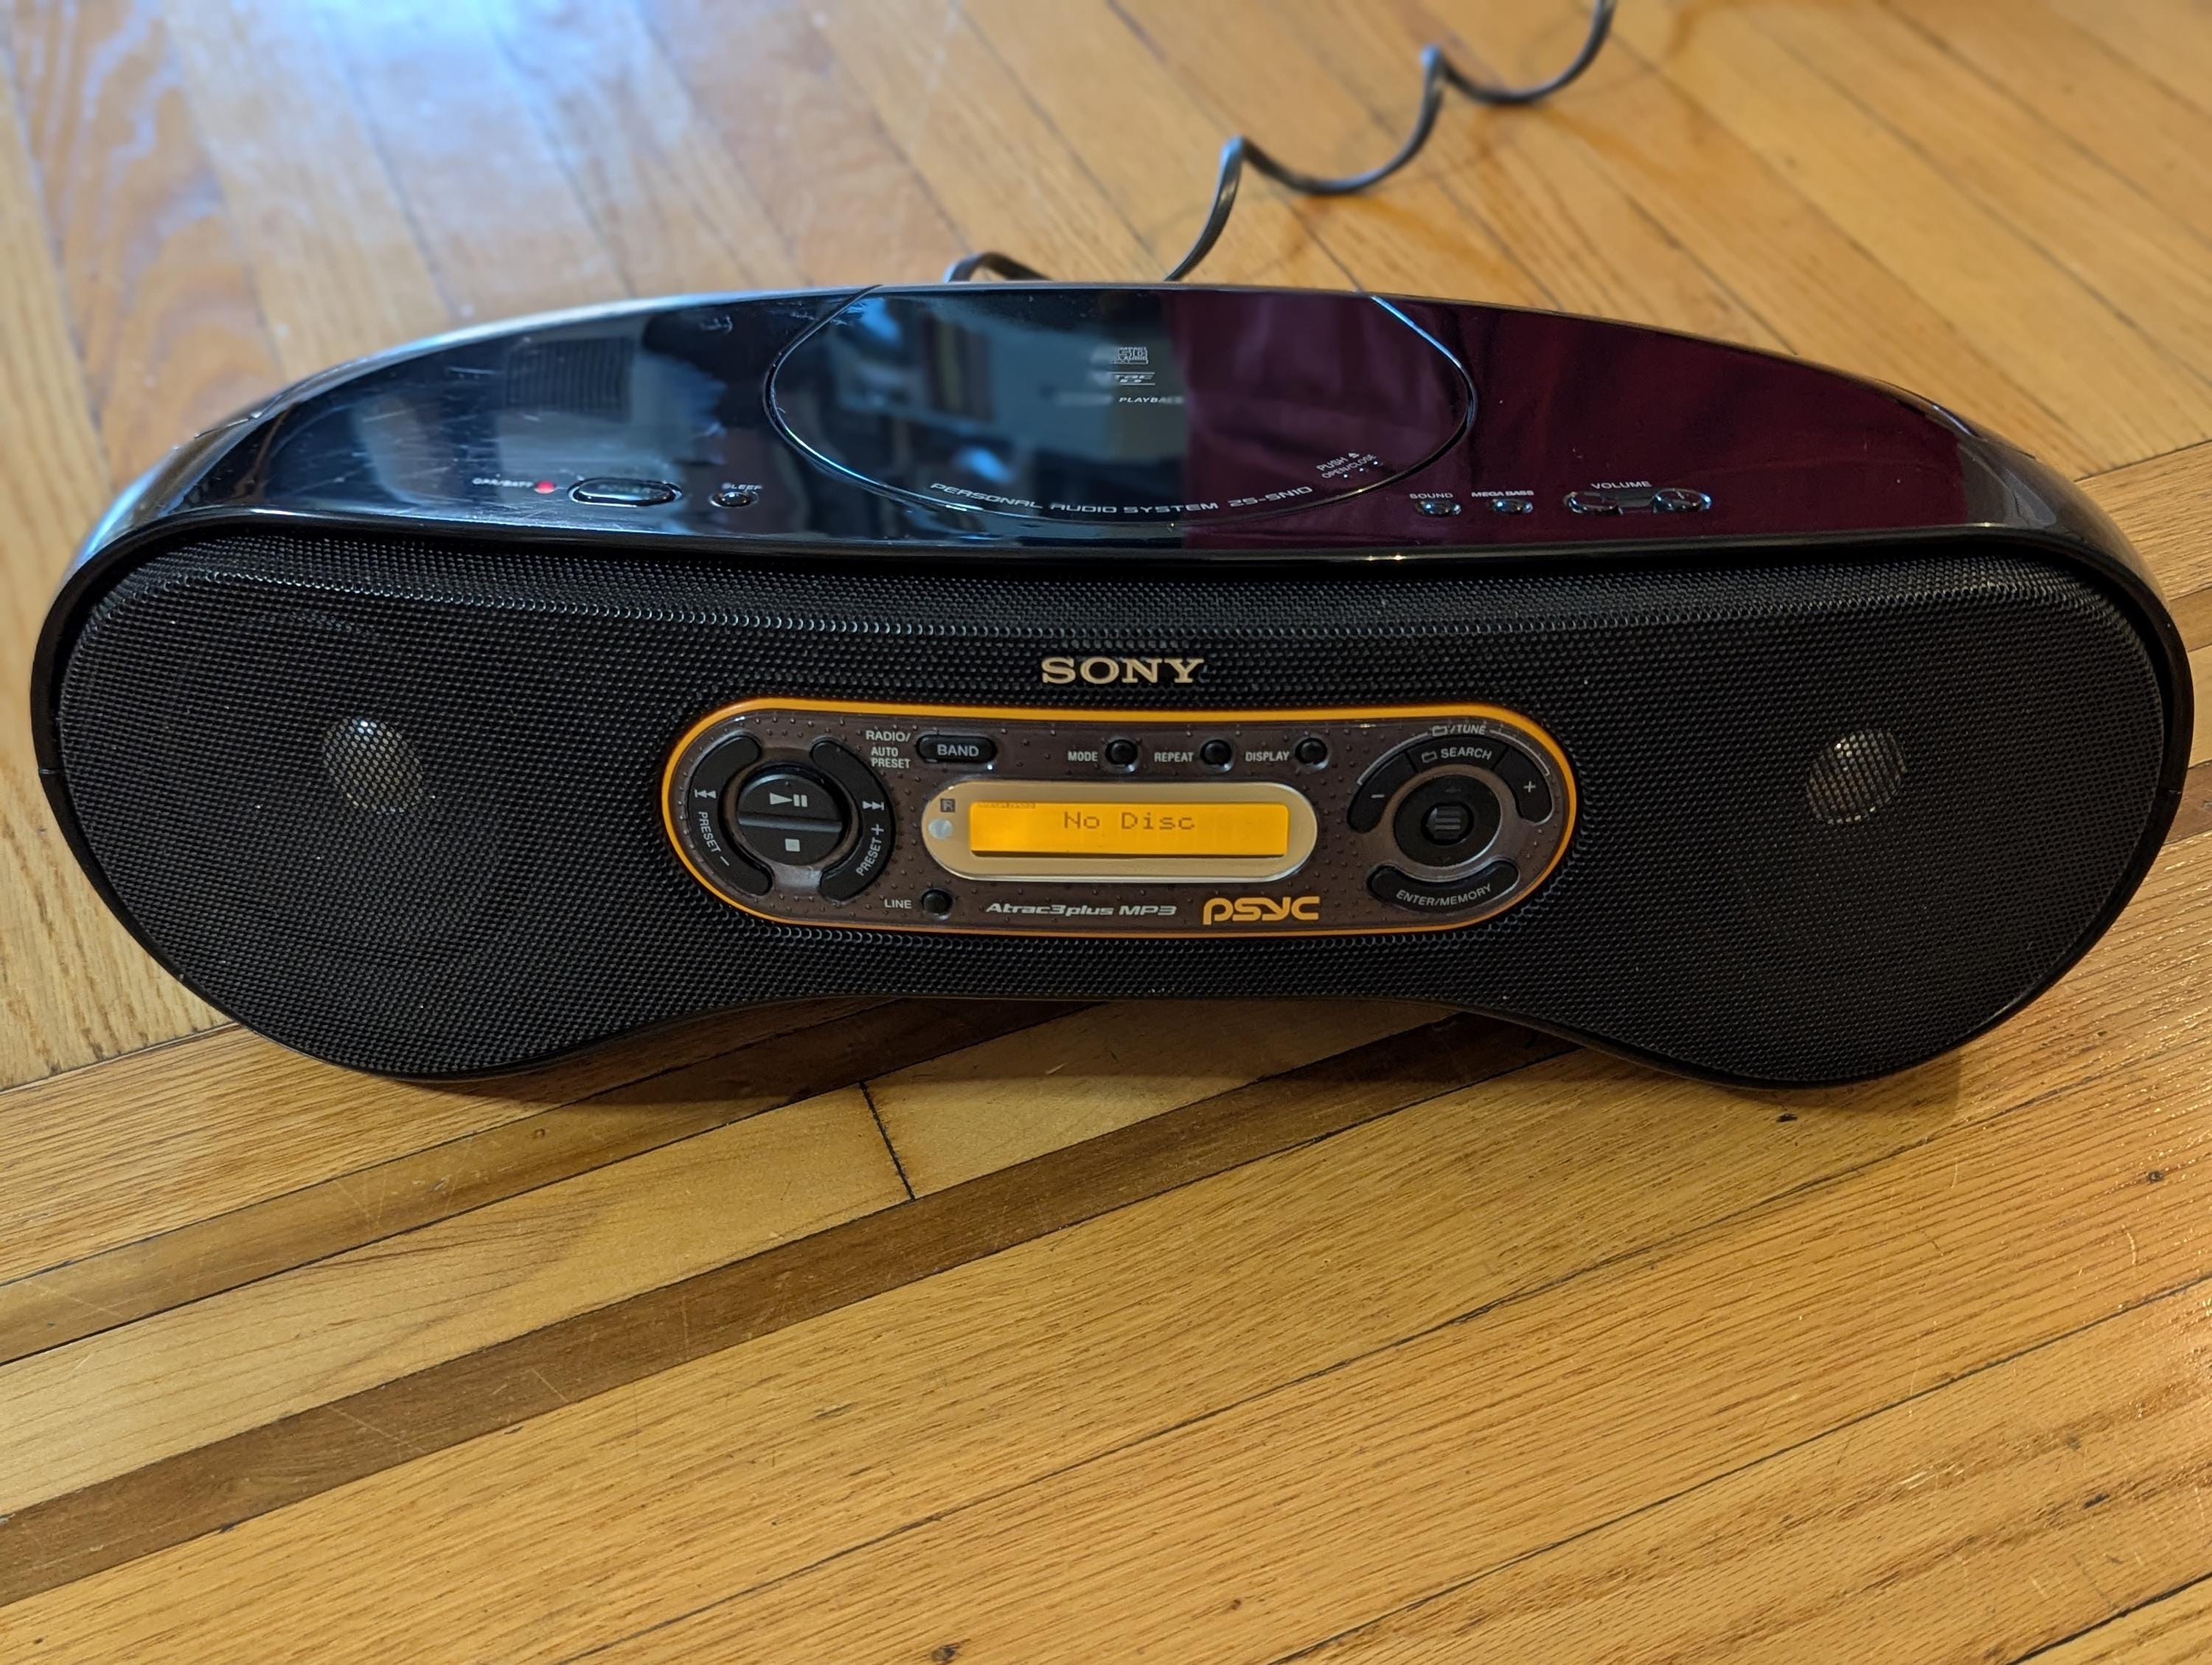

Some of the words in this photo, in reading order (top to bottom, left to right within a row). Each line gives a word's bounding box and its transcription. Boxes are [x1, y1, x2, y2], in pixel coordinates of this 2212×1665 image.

[1316, 456, 1349, 471] PUSH
[1321, 453, 1377, 479] OPEN/CLOSE
[1590, 481, 1652, 490] VOLUME
[930, 483, 1043, 509] PERSONAL
[1050, 503, 1117, 513] AUDIO
[1123, 502, 1219, 513] SYSTEM
[1228, 486, 1313, 507] ZS-SN10
[1041, 656, 1205, 684] SONY
[866, 730, 911, 743] RADIO/
[871, 746, 898, 757] AUTO
[936, 744, 979, 757] BAND
[1068, 751, 1099, 762] MODE
[1154, 751, 1194, 762] REPEAT
[1245, 751, 1290, 762] DISPLAY
[1441, 746, 1492, 759] SEARCH
[871, 758, 911, 768] PRESET
[1064, 811, 1099, 829] No
[1121, 812, 1195, 830] Disc
[698, 810, 722, 853] PRESET
[855, 838, 883, 876] PRESET
[1396, 883, 1492, 906] ENTER/MEMORY
[884, 899, 912, 909] LINE
[986, 903, 1114, 917] Atrac3plus
[1119, 906, 1177, 916] MP3
